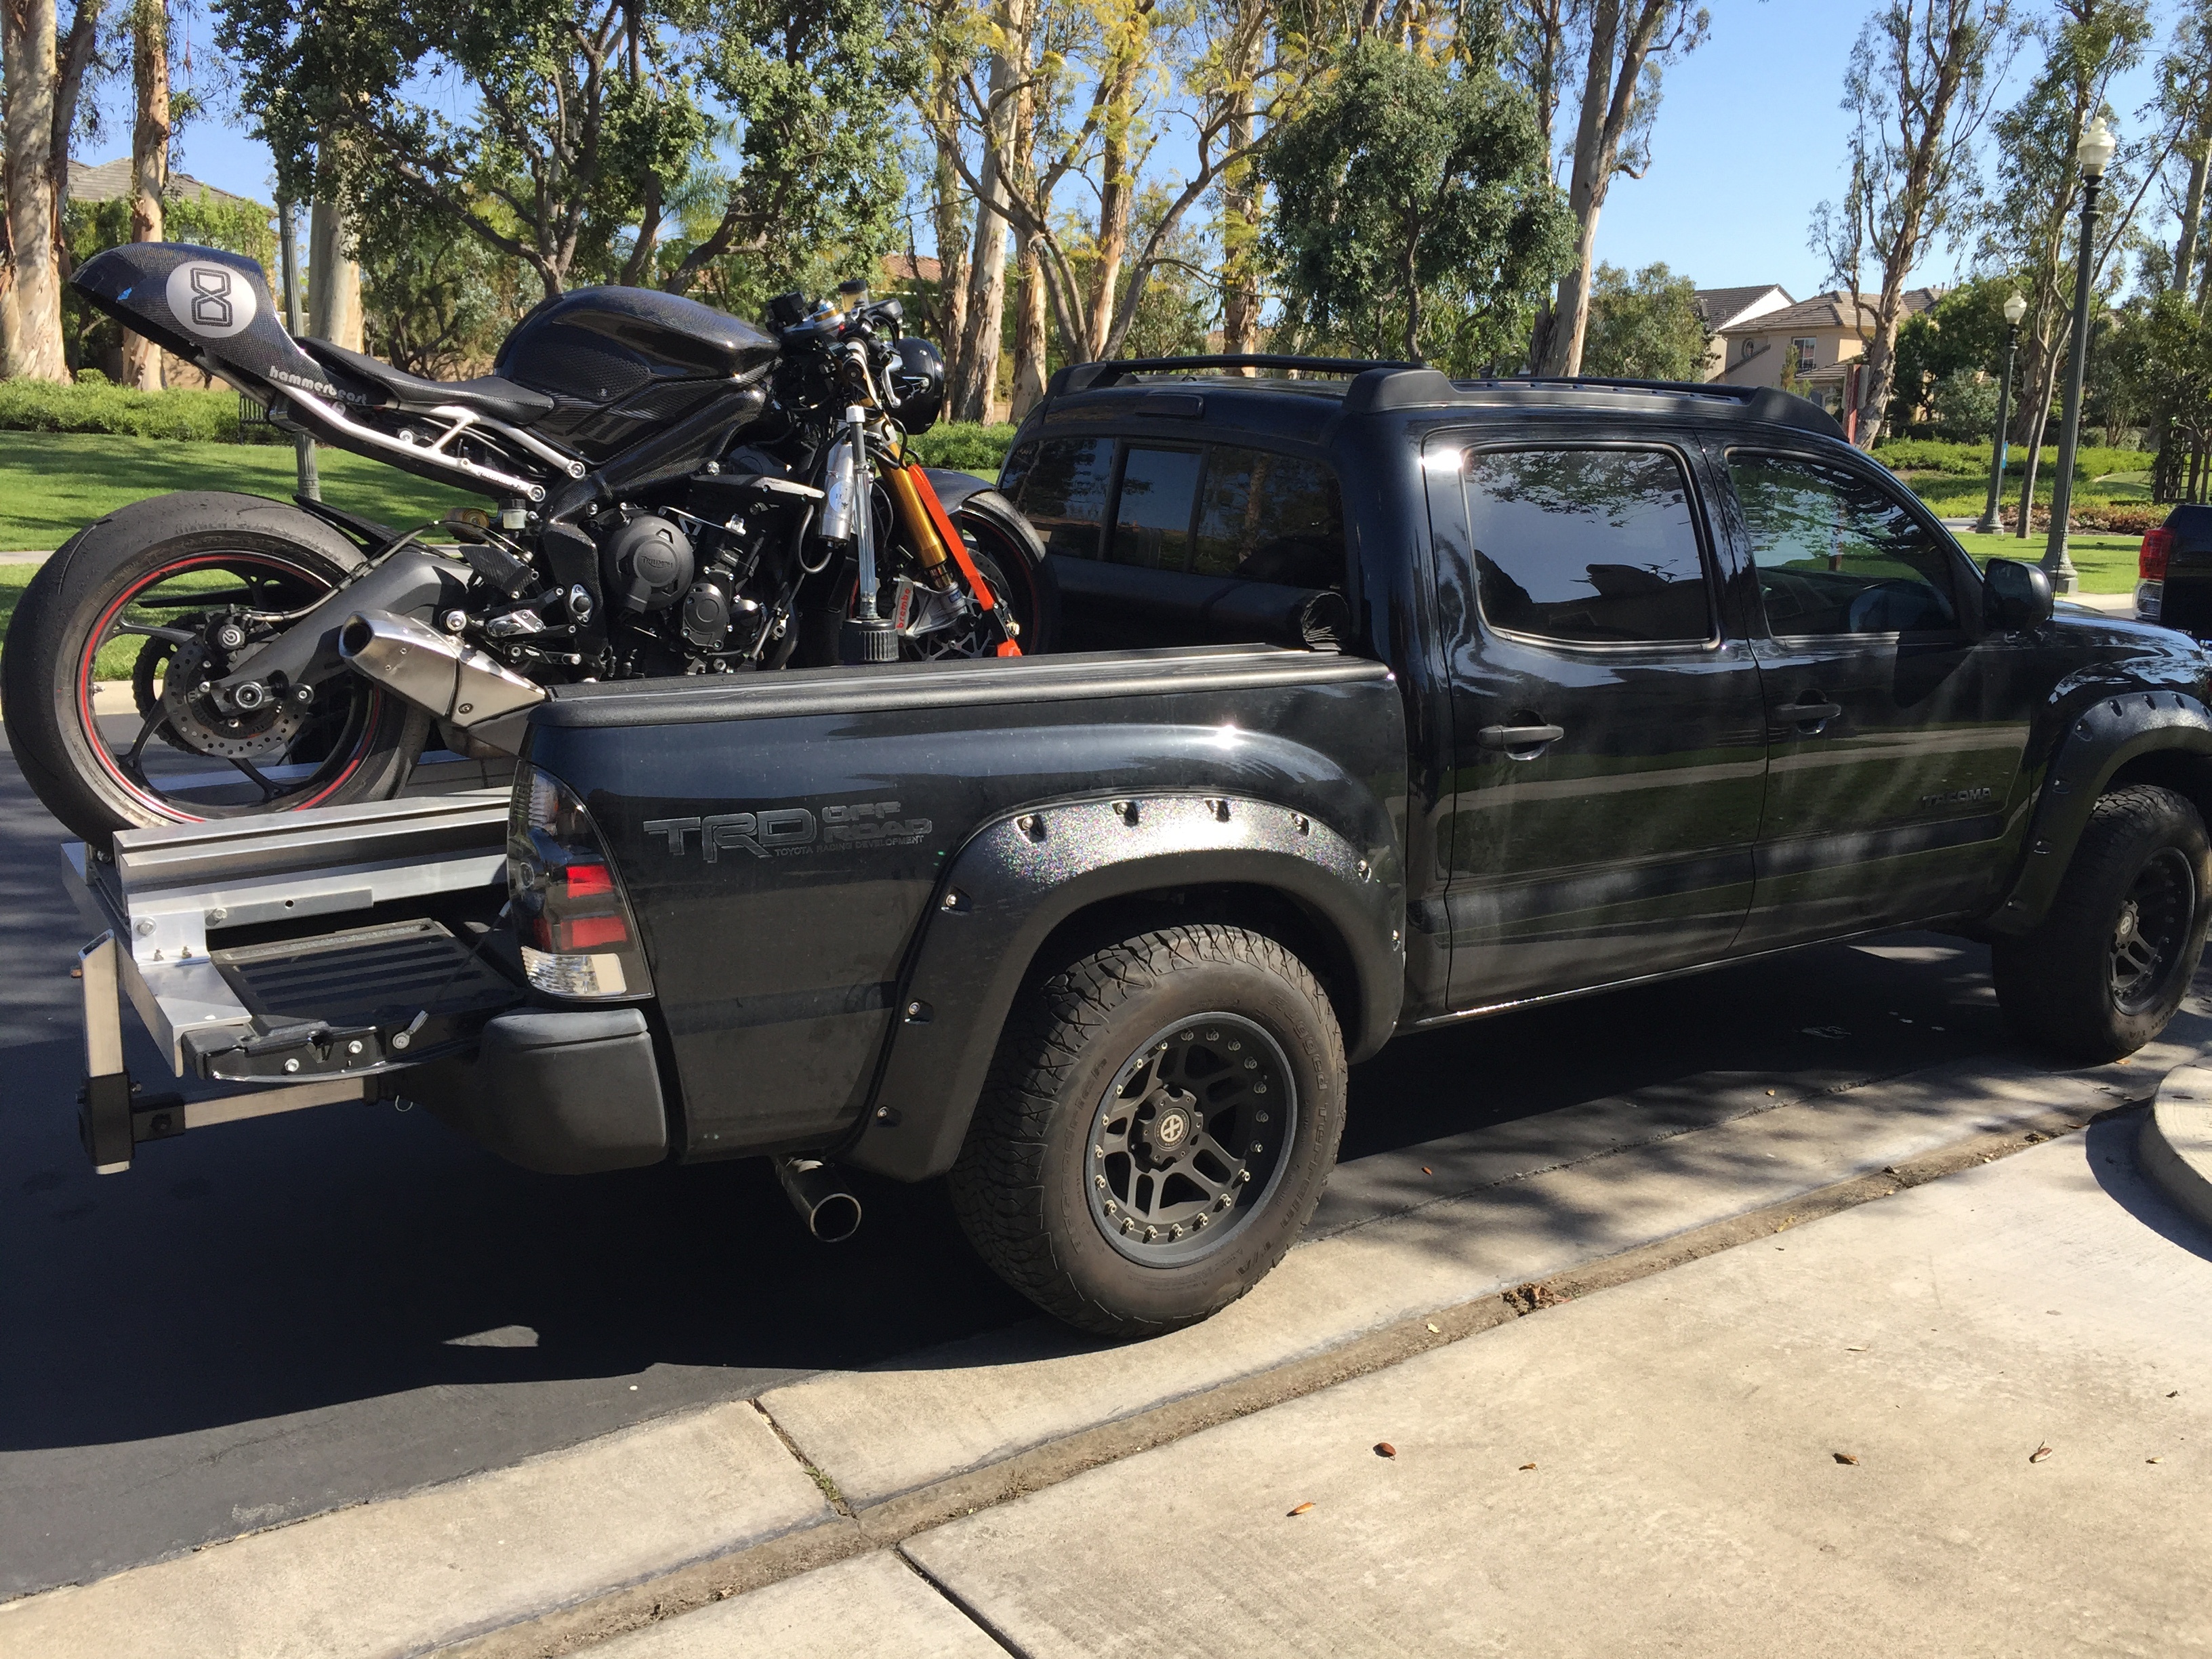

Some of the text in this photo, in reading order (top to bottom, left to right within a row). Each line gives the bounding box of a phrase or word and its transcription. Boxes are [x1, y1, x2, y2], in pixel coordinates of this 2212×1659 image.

[269, 365, 367, 405] hammerbeast
[896, 588, 911, 629] brembo
[1921, 787, 1992, 807] TACOMA
[822, 801, 901, 823] OFF
[643, 808, 817, 863] TRD
[823, 818, 933, 843] ROAD
[774, 835, 924, 857] TOYOTA RACING DEVELOPMENT
